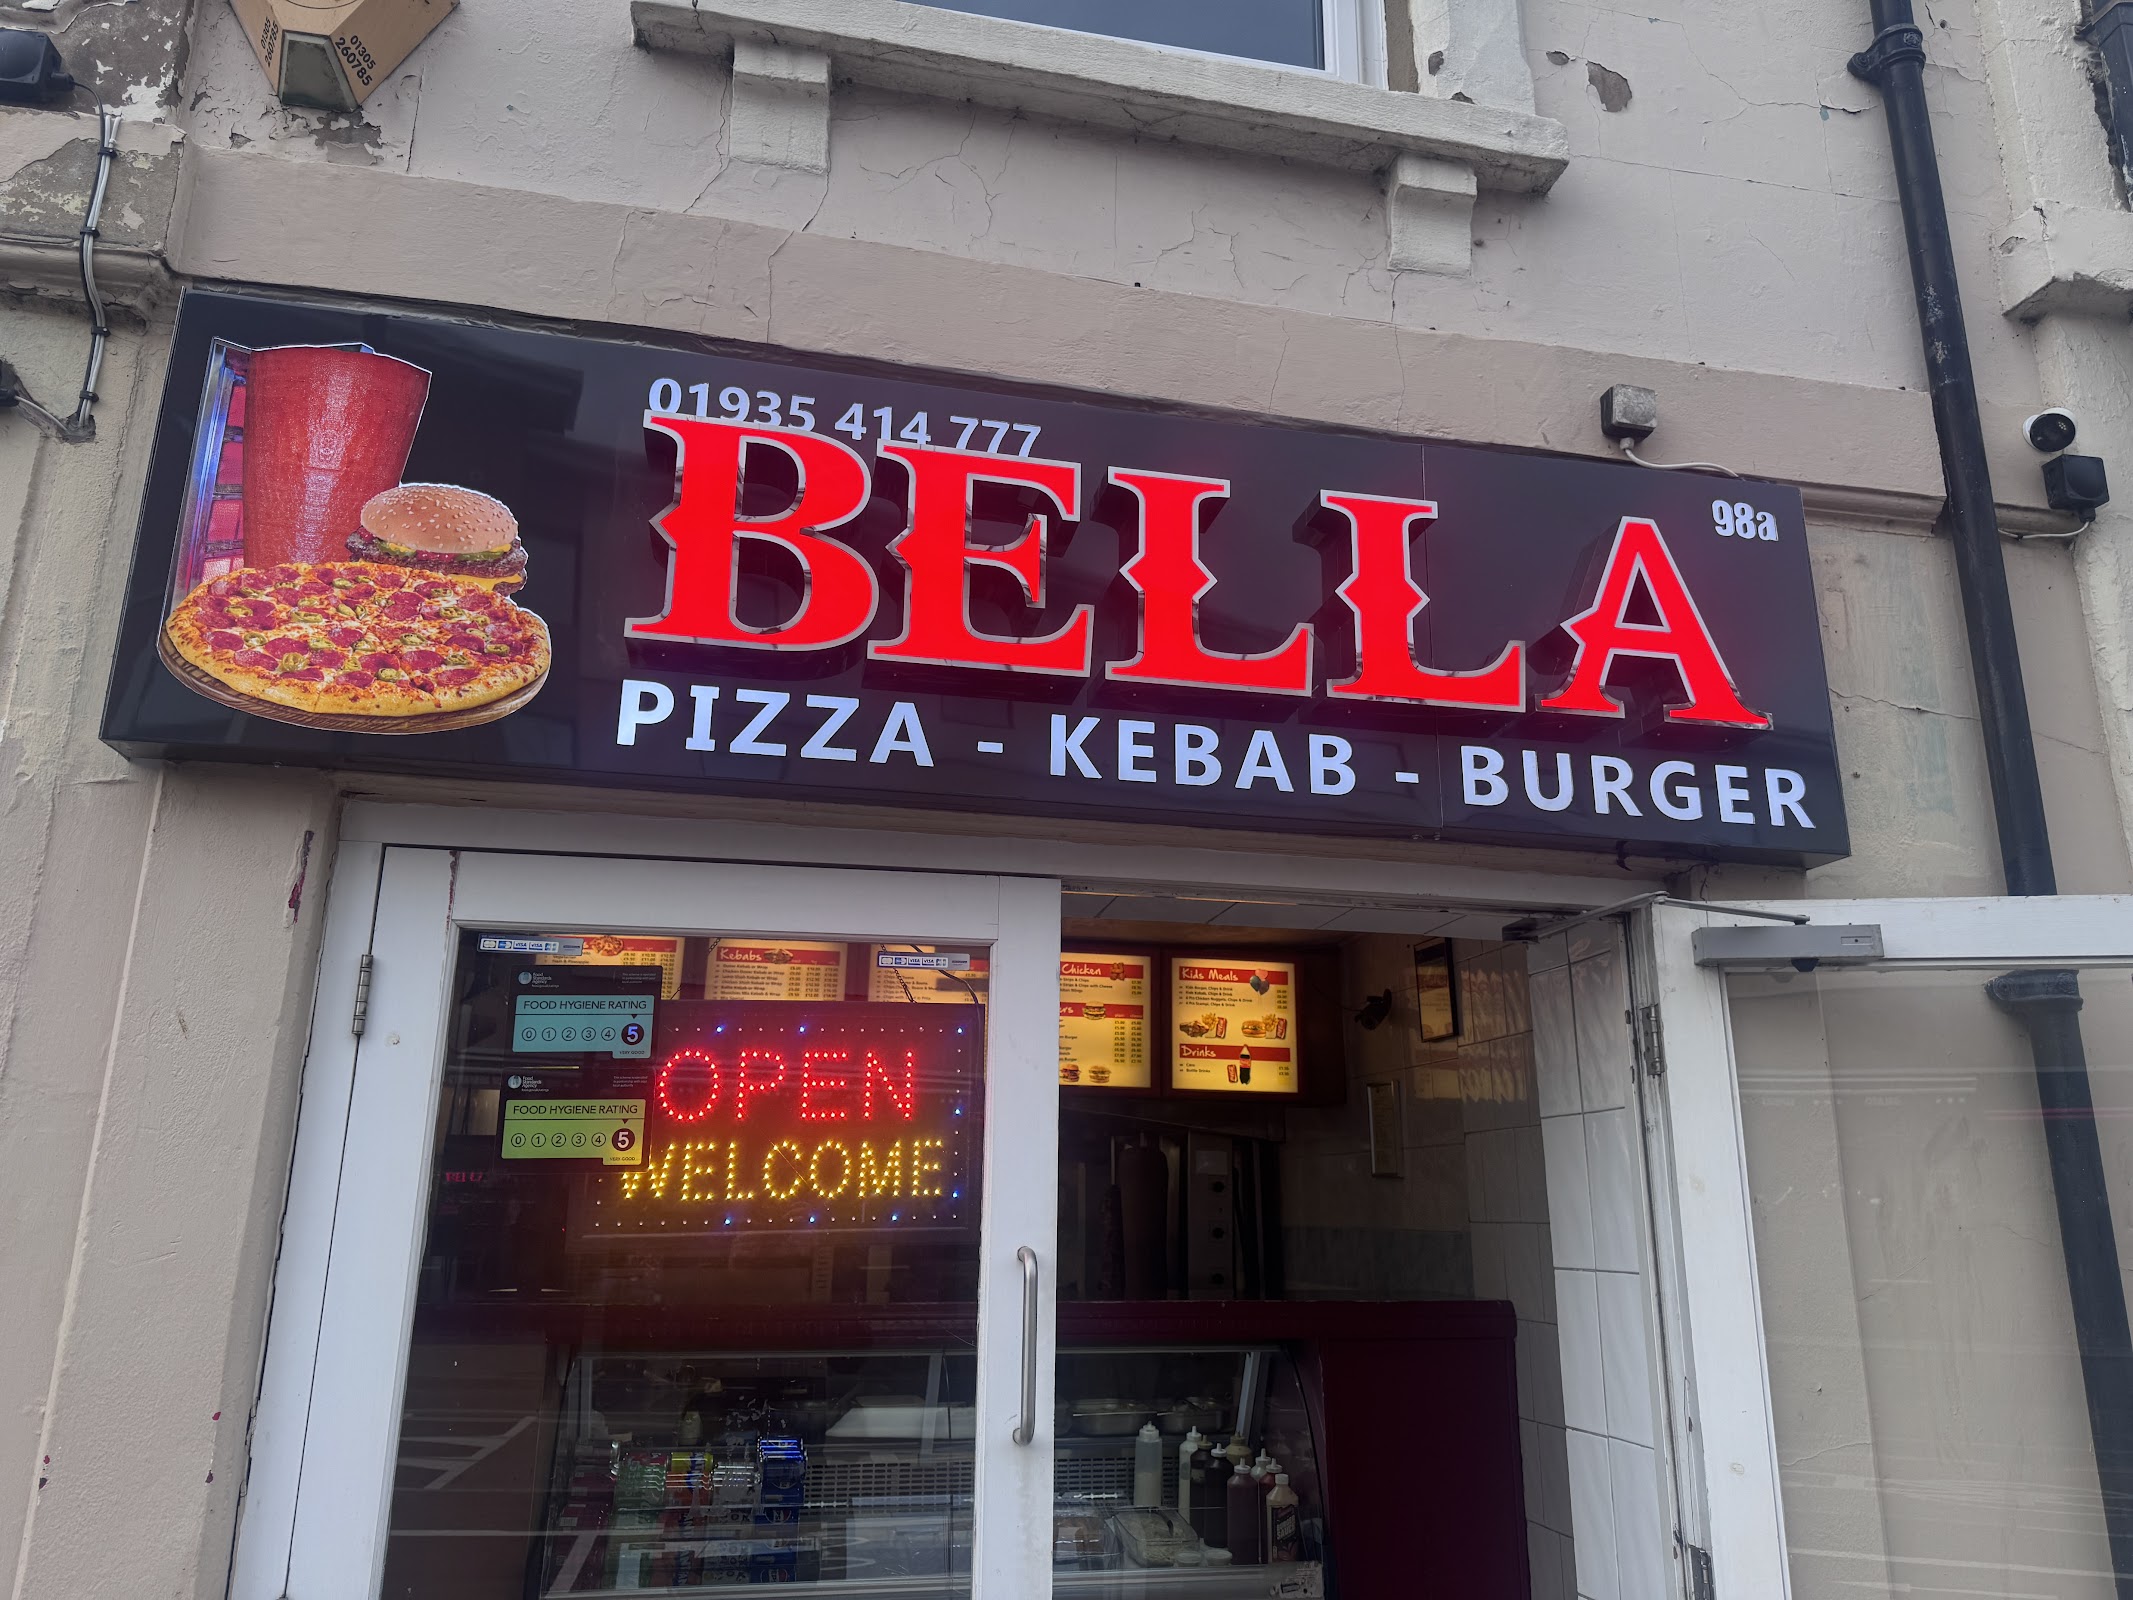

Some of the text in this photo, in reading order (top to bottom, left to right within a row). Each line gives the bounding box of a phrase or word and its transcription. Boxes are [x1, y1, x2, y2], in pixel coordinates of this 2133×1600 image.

[260, 16, 271, 49] 01305
[264, 20, 279, 68] 260785
[334, 36, 373, 86] 260785
[350, 35, 376, 70] 01305
[648, 378, 1043, 459] 01935 414 777
[1711, 499, 1779, 542] 98a
[623, 408, 1775, 731] BELLA
[616, 678, 935, 768] PIZZA
[1050, 713, 1358, 797] KEBAB
[1460, 745, 1818, 829] BURGER
[720, 947, 762, 962] Kebabs
[1061, 963, 1102, 976] Chicken
[1182, 967, 1239, 982] Kids Meals
[523, 1000, 647, 1010] FOOD HYGIENE RATING
[626, 1026, 639, 1043] 5
[1181, 1044, 1217, 1058] Drinks
[657, 1046, 918, 1122] OPEN
[513, 1104, 639, 1115] FOOD HYGIENE RATING
[616, 1131, 630, 1149] 5
[619, 1138, 944, 1201] WELCOME
